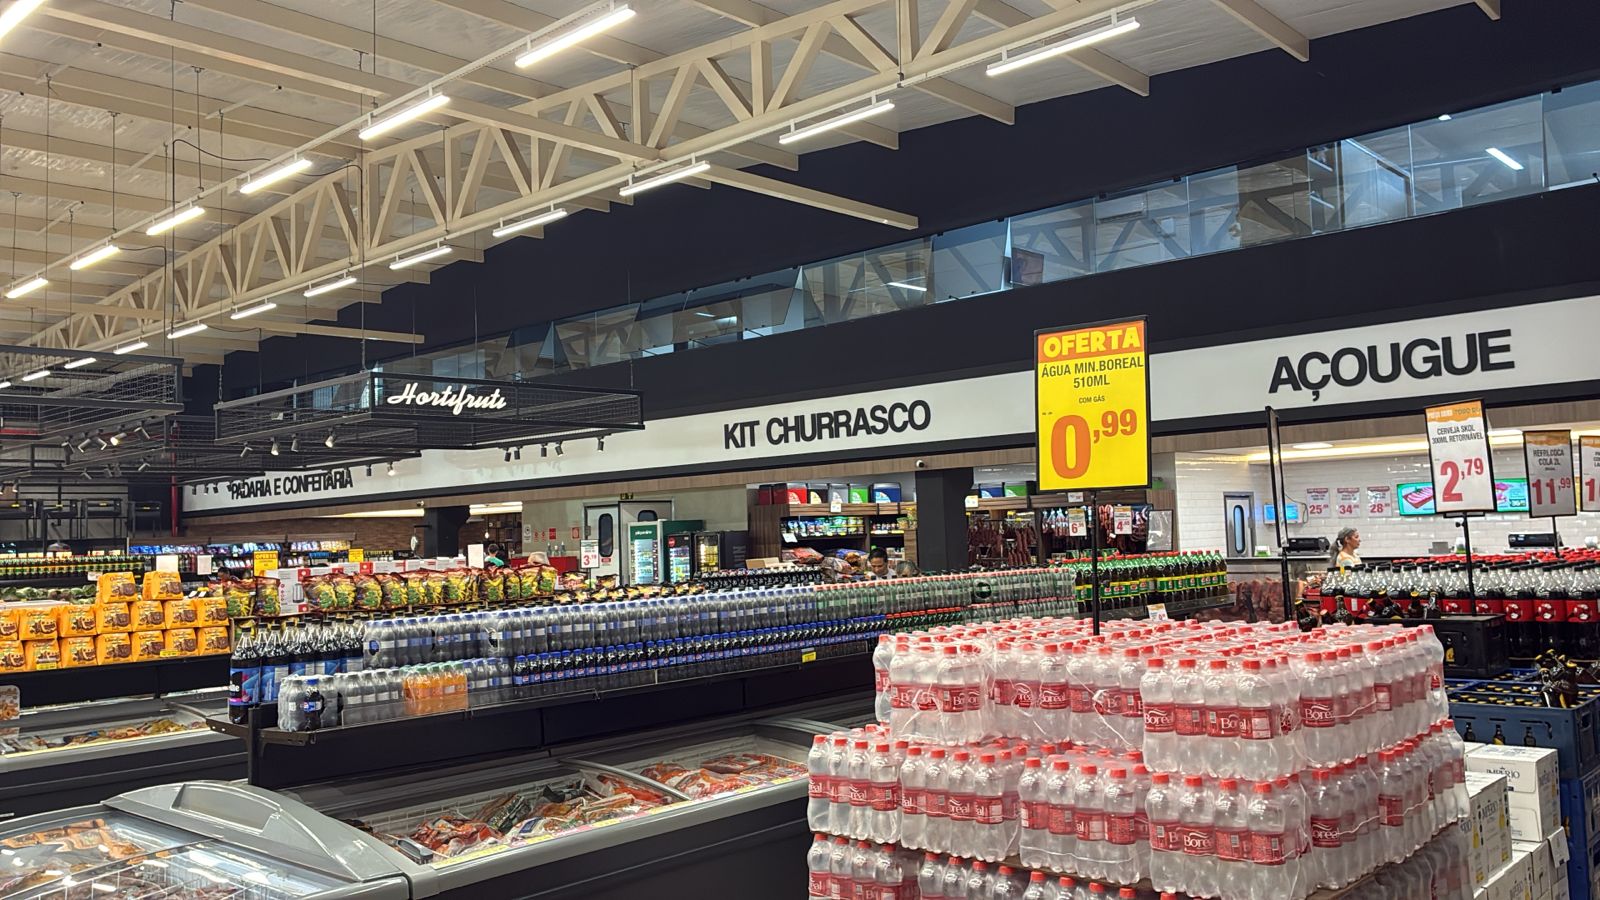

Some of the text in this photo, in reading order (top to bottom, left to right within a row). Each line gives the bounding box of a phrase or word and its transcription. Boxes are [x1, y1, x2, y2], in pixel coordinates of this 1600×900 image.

[1043, 327, 1140, 357] OFERTA
[1041, 356, 1144, 377] ÁGUA MIN.BOREAL
[1268, 328, 1515, 401] AÇOUGUE
[1073, 374, 1110, 388] 510ML
[387, 382, 507, 415] Hortifruti
[1079, 394, 1105, 404] COM GÁS
[724, 399, 932, 449] KIT CHURRASCO
[1437, 424, 1475, 435] CERVEJA SKOL
[1051, 409, 1138, 479] 0,99
[231, 478, 272, 500] PADARIA
[274, 478, 281, 496] E
[1440, 458, 1484, 502] 2,79
[1532, 478, 1571, 504] 11,99
